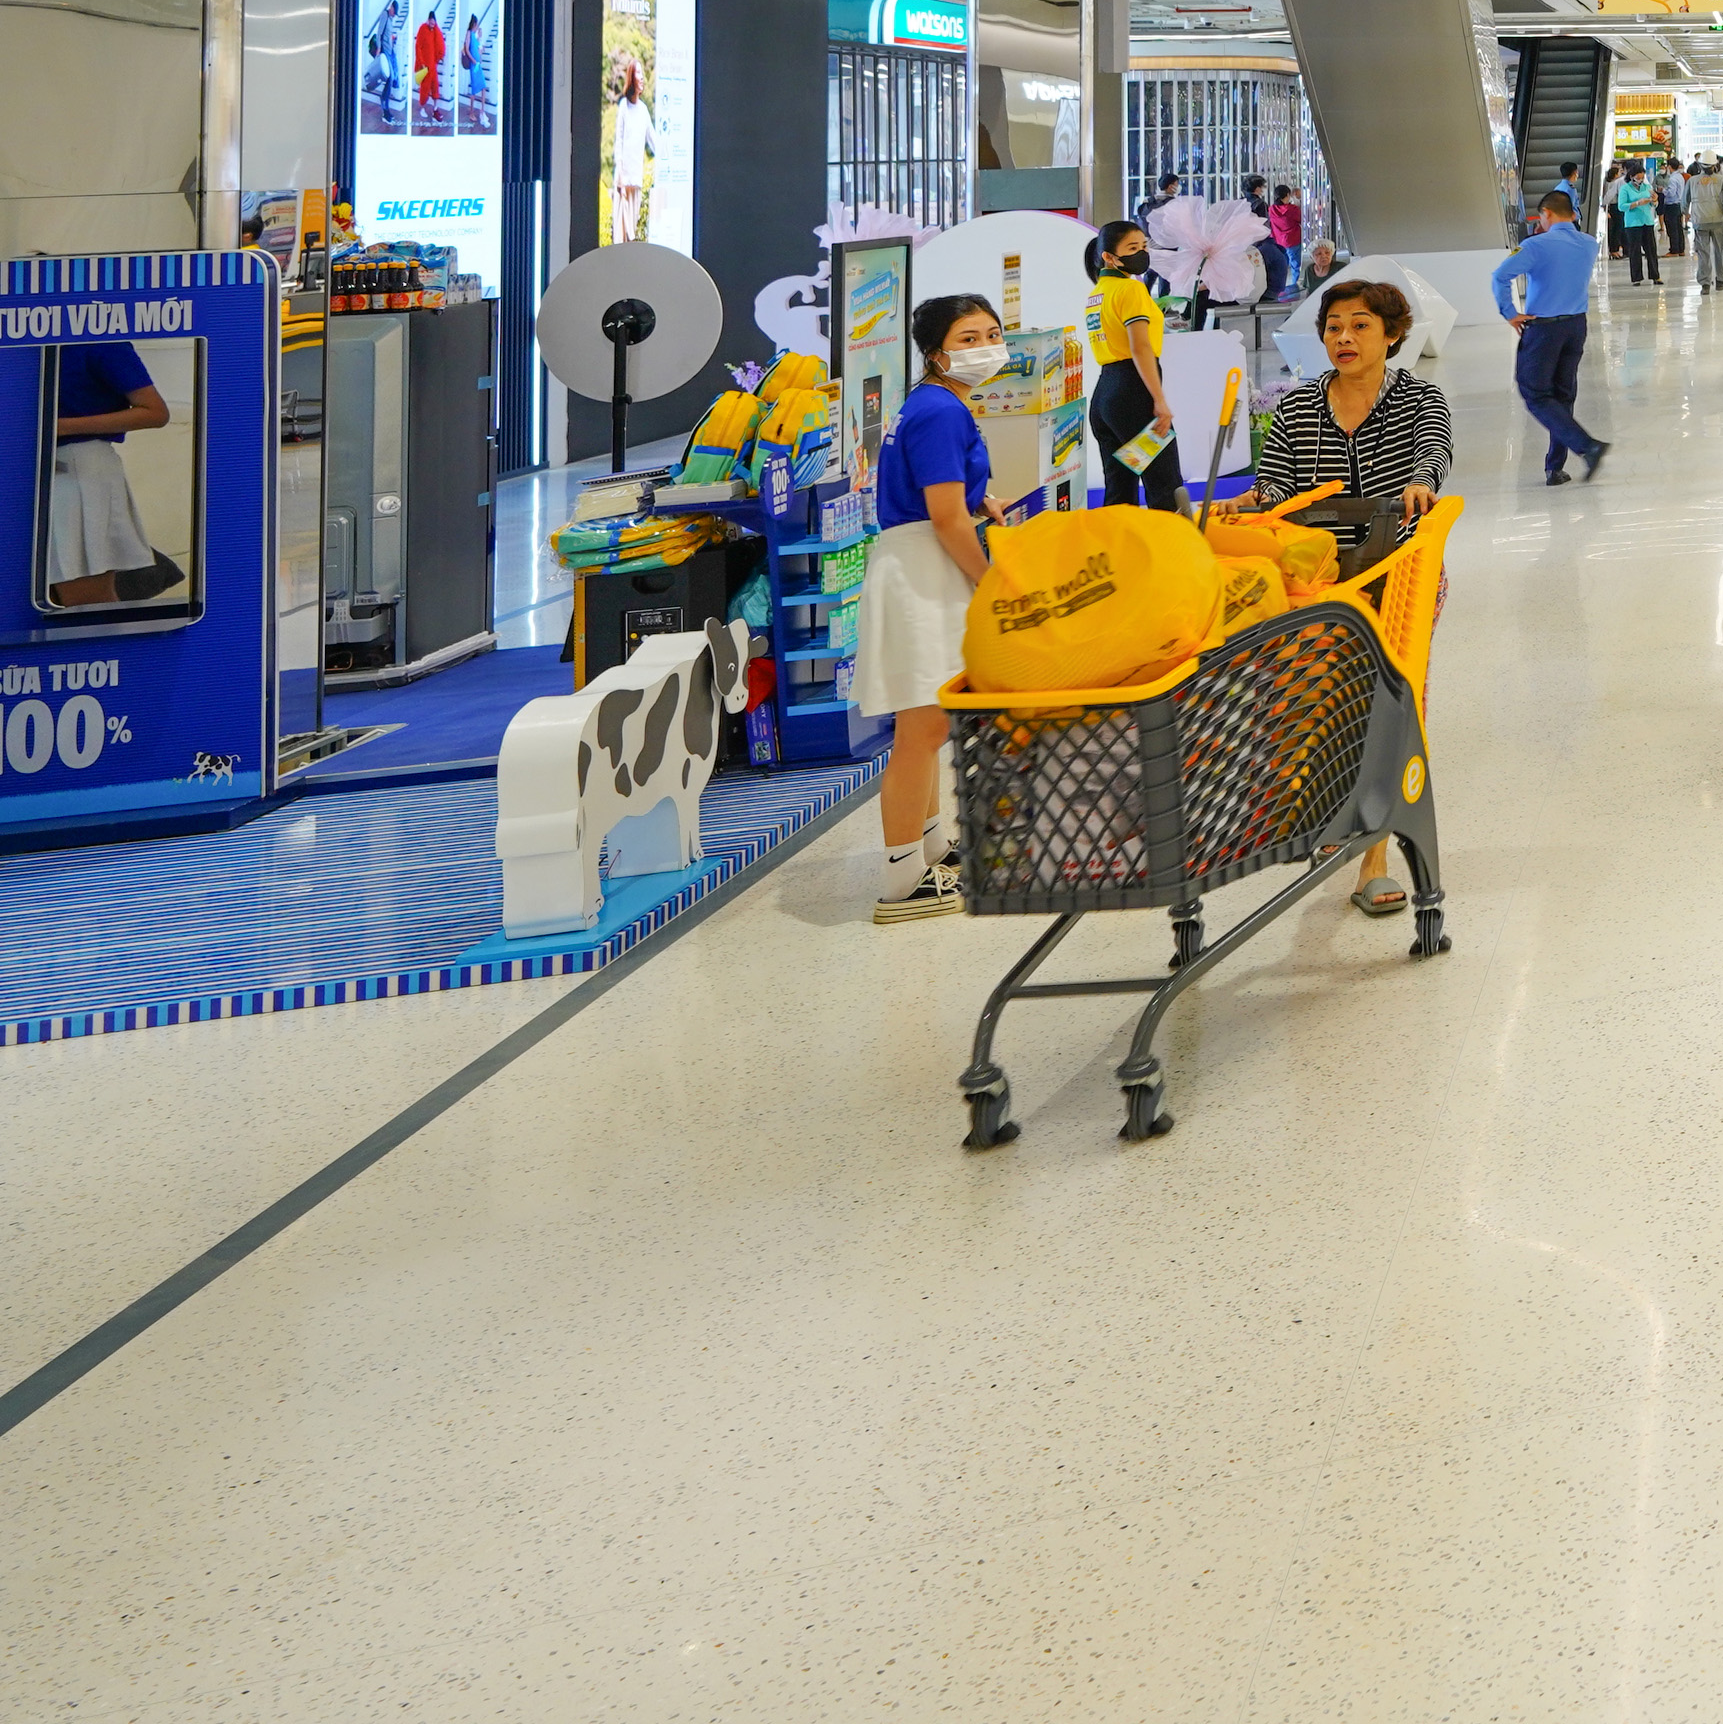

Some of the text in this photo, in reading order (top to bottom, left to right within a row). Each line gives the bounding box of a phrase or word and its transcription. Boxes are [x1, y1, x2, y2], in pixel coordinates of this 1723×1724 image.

[906, 8, 964, 39] watsons
[377, 198, 485, 220] SKECHERS
[66, 300, 129, 336] VỪA
[135, 296, 193, 332] MỚI
[0, 659, 119, 696] ỮA TƯƠI
[0, 694, 133, 775] 00%
